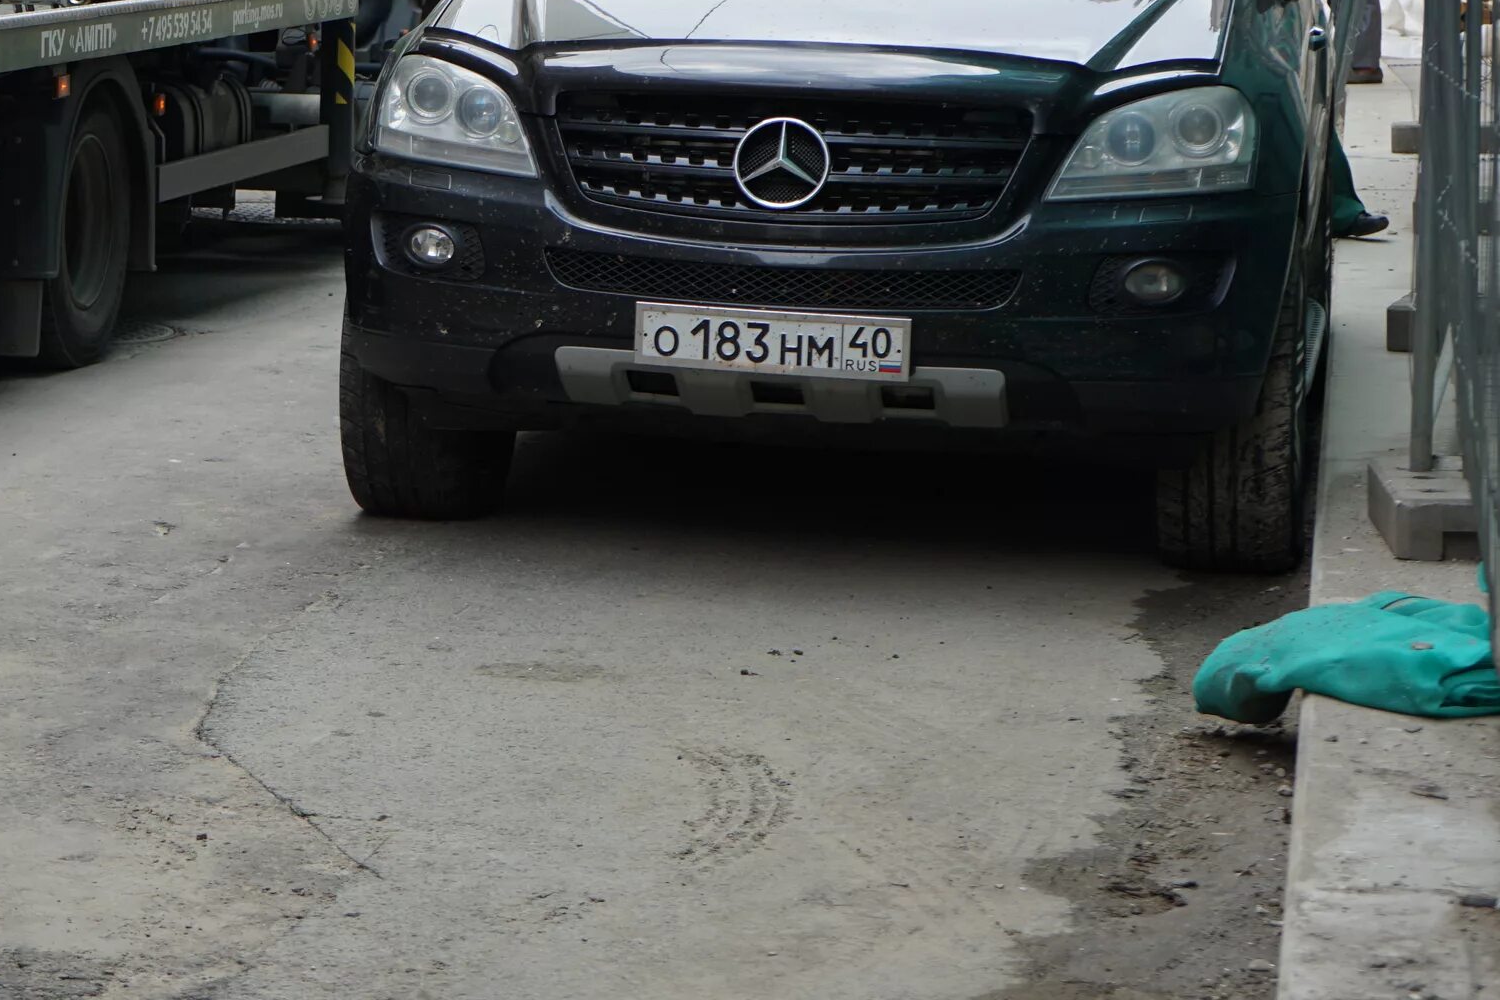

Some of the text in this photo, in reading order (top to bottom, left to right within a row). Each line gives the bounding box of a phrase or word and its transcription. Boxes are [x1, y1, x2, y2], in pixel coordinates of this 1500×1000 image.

[141, 16, 155, 44] +7
[156, 13, 173, 42] 495
[173, 11, 190, 39] 539
[232, 0, 284, 33] parking.mos.ru
[40, 28, 66, 59] ГКУ
[848, 326, 892, 359] 40
[845, 359, 877, 372] RUS
